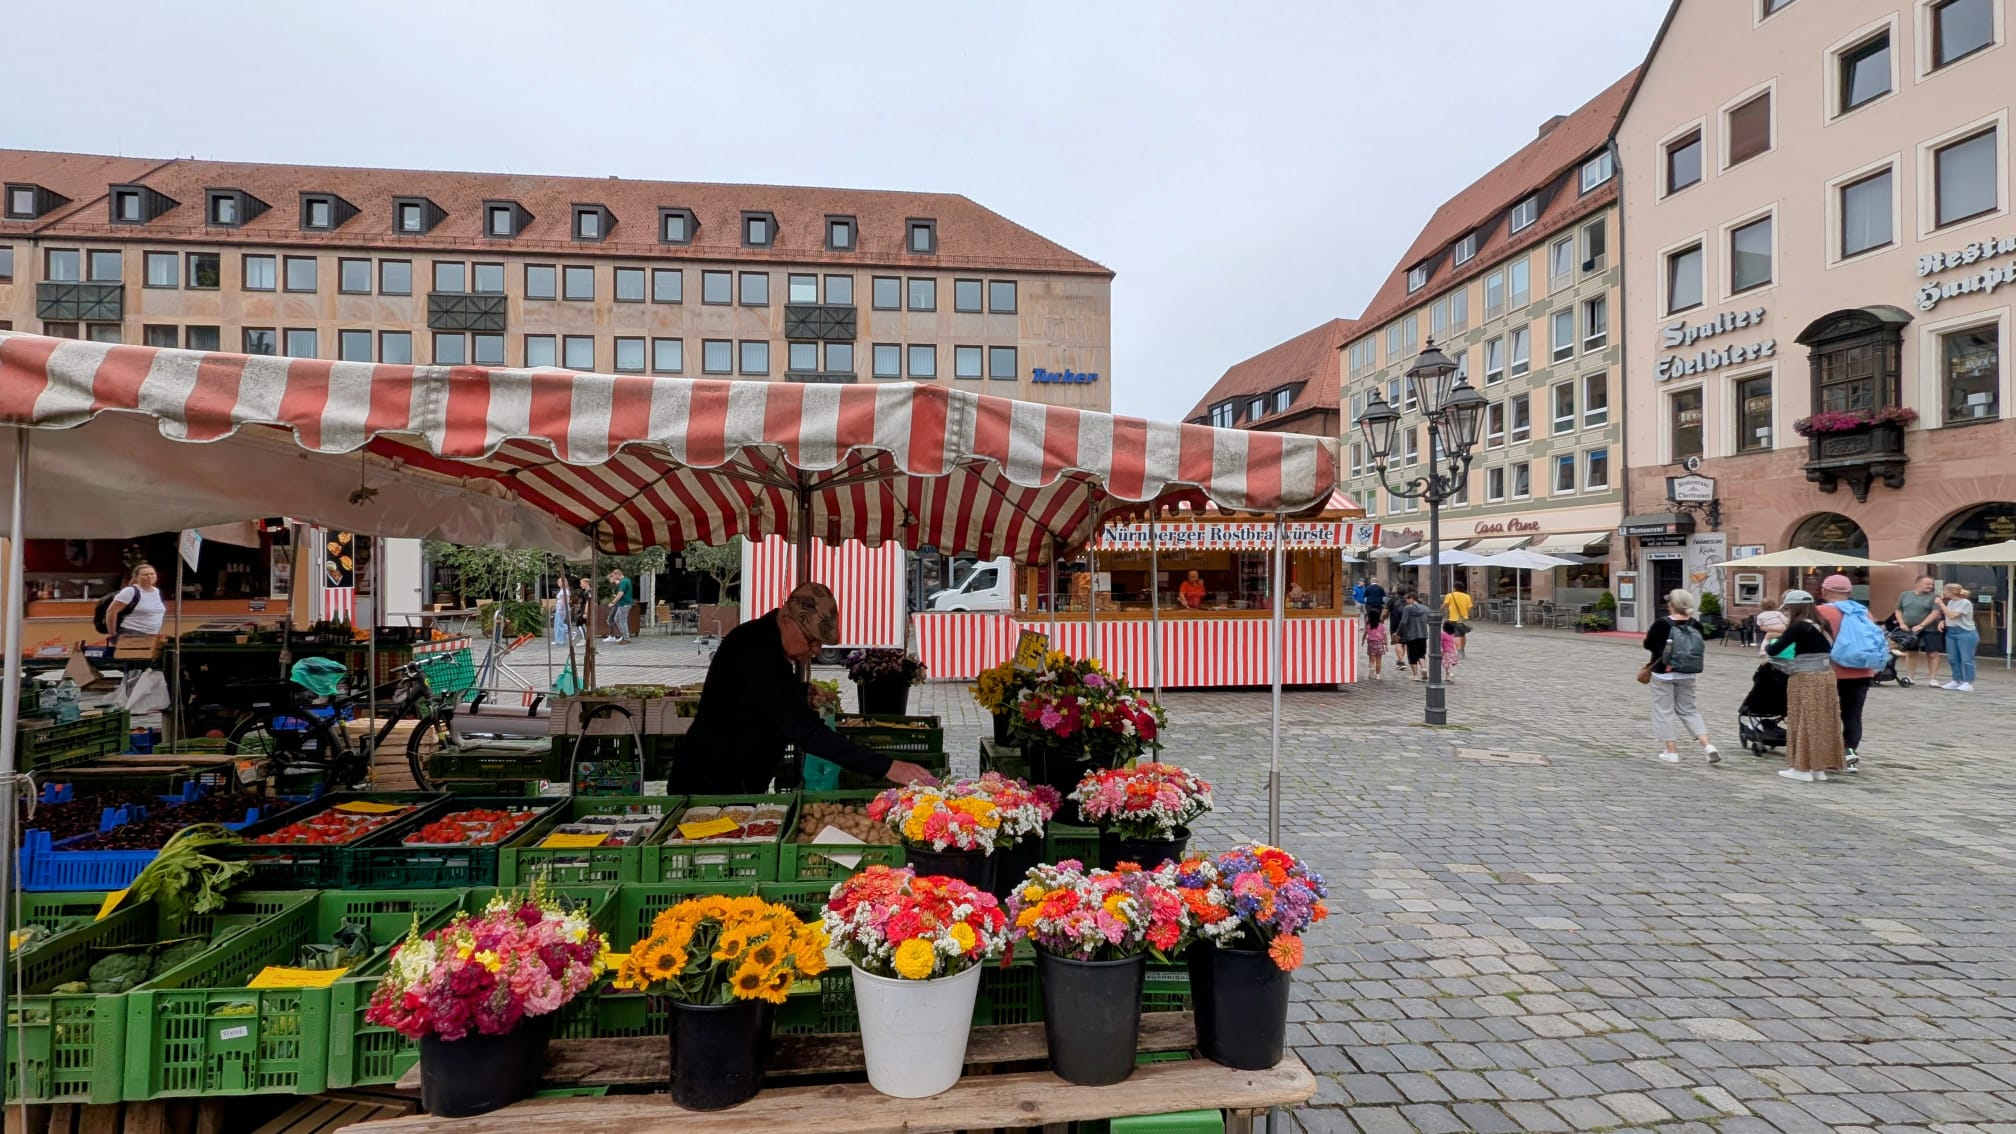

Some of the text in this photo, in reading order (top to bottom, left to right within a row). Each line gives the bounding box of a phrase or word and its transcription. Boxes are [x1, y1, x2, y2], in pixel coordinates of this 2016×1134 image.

[1663, 307, 1767, 348] Spalter
[1654, 339, 1777, 382] Edelbiere
[1032, 368, 1098, 384] Tucher
[1474, 518, 1540, 534] Casa Pane
